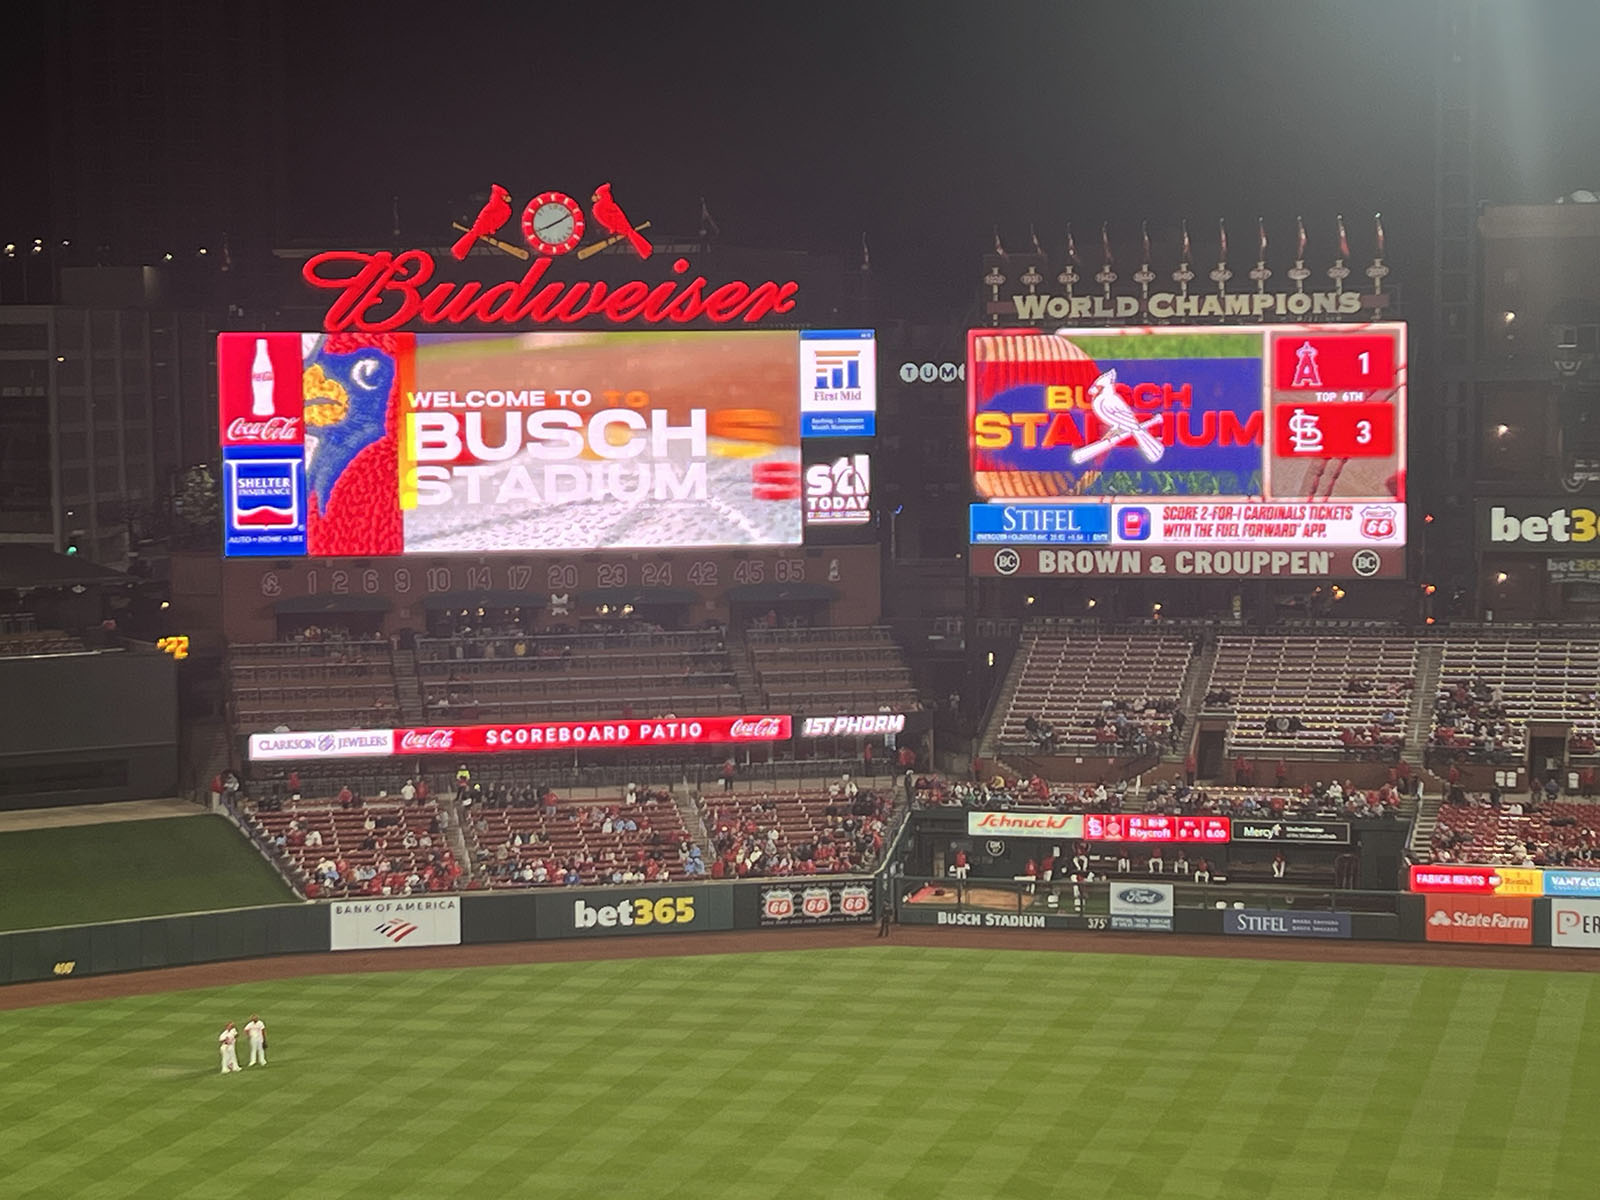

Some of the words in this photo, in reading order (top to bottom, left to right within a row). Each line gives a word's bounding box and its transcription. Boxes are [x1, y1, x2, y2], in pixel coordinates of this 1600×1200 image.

[302, 250, 798, 332] Budweiser
[1013, 294, 1139, 320] WORLD
[1148, 292, 1362, 318] CHAMPIONS
[1357, 352, 1370, 375] 1
[902, 364, 964, 381] TUM
[407, 390, 546, 408] WELCOME
[555, 389, 592, 407] TO
[814, 391, 838, 401] First
[840, 391, 862, 401] Mid
[1315, 392, 1337, 402] TOP
[1342, 392, 1364, 402] 6TH
[227, 416, 300, 441] Coca-Cola
[406, 408, 708, 461] BUSCH
[1356, 420, 1371, 444] 3
[237, 477, 291, 489] SHELTER
[806, 454, 869, 496] stl
[403, 462, 708, 508] STADIUM
[807, 496, 869, 510] TODAY
[1003, 506, 1081, 531] STIFEL
[1163, 506, 1199, 520] SCORE
[1243, 506, 1305, 520] CARDINALS
[1308, 506, 1353, 520] TICKETS
[1163, 523, 1192, 537] WITH
[1194, 523, 1214, 537] THE
[1215, 523, 1240, 537] FUEL
[1302, 523, 1327, 537] APP.
[1366, 519, 1391, 534] 66
[1491, 507, 1600, 542] bet3
[998, 554, 1018, 569] BC
[1038, 550, 1141, 574] BROWN
[1149, 555, 1167, 574] &
[1175, 550, 1330, 574] CROUPPEN
[1356, 555, 1378, 570] BC
[308, 570, 317, 594] 1
[331, 570, 349, 594] 2
[362, 569, 379, 593] 6
[395, 568, 411, 592] 9
[426, 567, 450, 592] 10
[466, 566, 492, 590] 14
[507, 566, 532, 590] 17
[548, 565, 578, 588] 20
[597, 564, 627, 588] 23
[641, 562, 672, 586] 24
[687, 562, 718, 586] 42
[733, 561, 764, 584] 45
[775, 560, 804, 582] 85
[485, 725, 630, 744] SCOREBOARD
[640, 722, 702, 739] PATIO
[730, 718, 781, 737] Coca-Cola
[259, 738, 316, 751] CLARKSON
[338, 735, 388, 749] JEWELERS
[401, 729, 454, 749] Coca-Cola
[978, 814, 1073, 829] Schnucks
[1129, 828, 1171, 839] Roycroft
[1243, 826, 1274, 840] Mercy
[845, 898, 864, 910] 66
[1126, 890, 1156, 902] Ford
[336, 905, 372, 914] BANK
[376, 903, 392, 912] OF
[396, 901, 455, 911] AMERICA
[574, 896, 695, 928] bet365
[770, 902, 788, 914] 66
[807, 899, 825, 912] 66
[938, 912, 981, 926] BUSCH
[985, 914, 1046, 928] STADIUM
[1237, 914, 1288, 932] STIFEL
